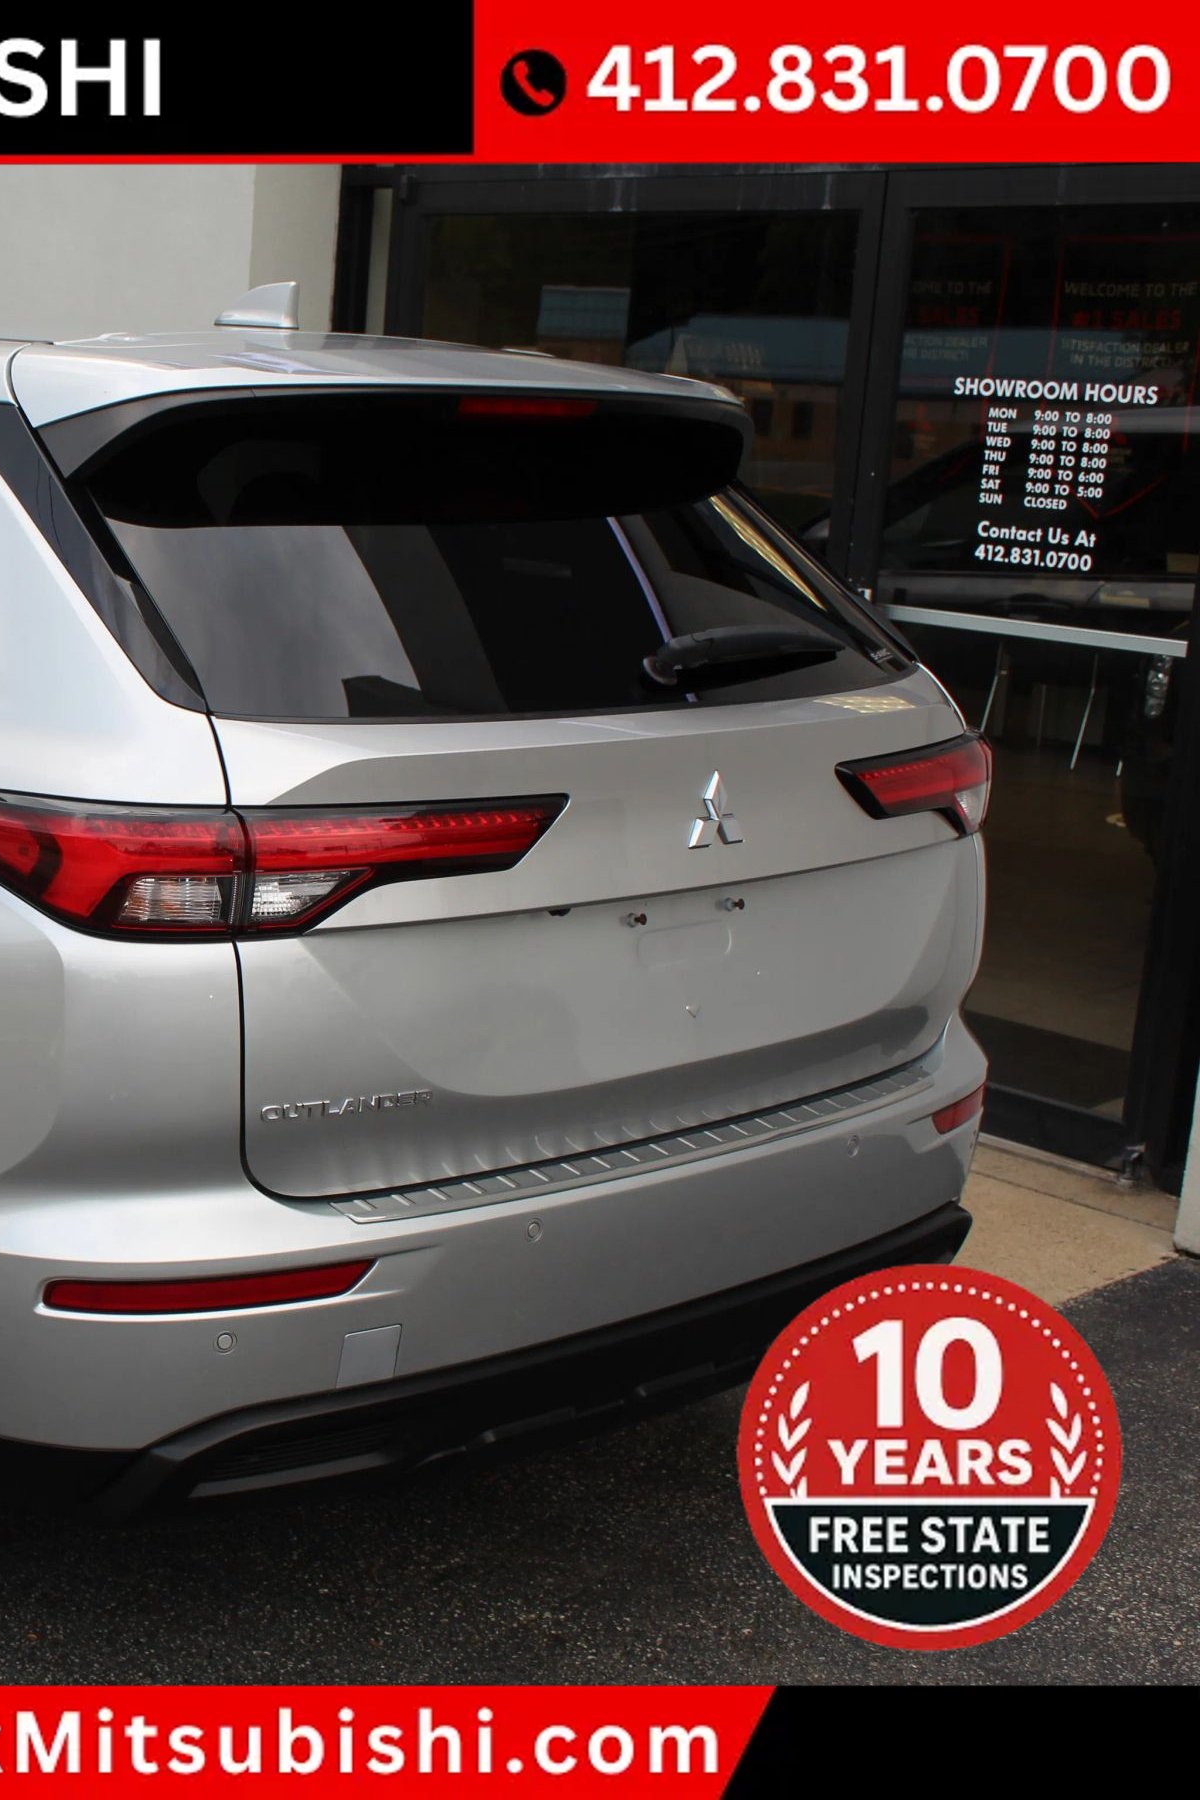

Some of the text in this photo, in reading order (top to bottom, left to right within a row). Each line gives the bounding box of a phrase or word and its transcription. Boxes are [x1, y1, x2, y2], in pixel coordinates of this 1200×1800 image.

[1064, 280, 1200, 298] WELCOME TO THE
[1110, 308, 1182, 331] SALES
[954, 377, 1159, 404] SHOWROOM HOURS
[988, 408, 1112, 425] MON 9:00 TO 8:00
[987, 422, 1110, 439] TUE 9:00 TO 8:00
[986, 436, 1108, 454] WED 9:00 TO 8:00
[984, 450, 1107, 469] THU 9:00 TO 8:00
[982, 464, 1104, 484] FRI 9:00 TO 6:00
[980, 479, 1103, 498] SAT 9:00 TO 5:00
[979, 493, 1067, 510] SUN CLOSED
[977, 520, 1096, 547] Contact Us At
[974, 543, 1092, 571] 412.831.0700
[261, 1089, 433, 1121] OUTLANDER
